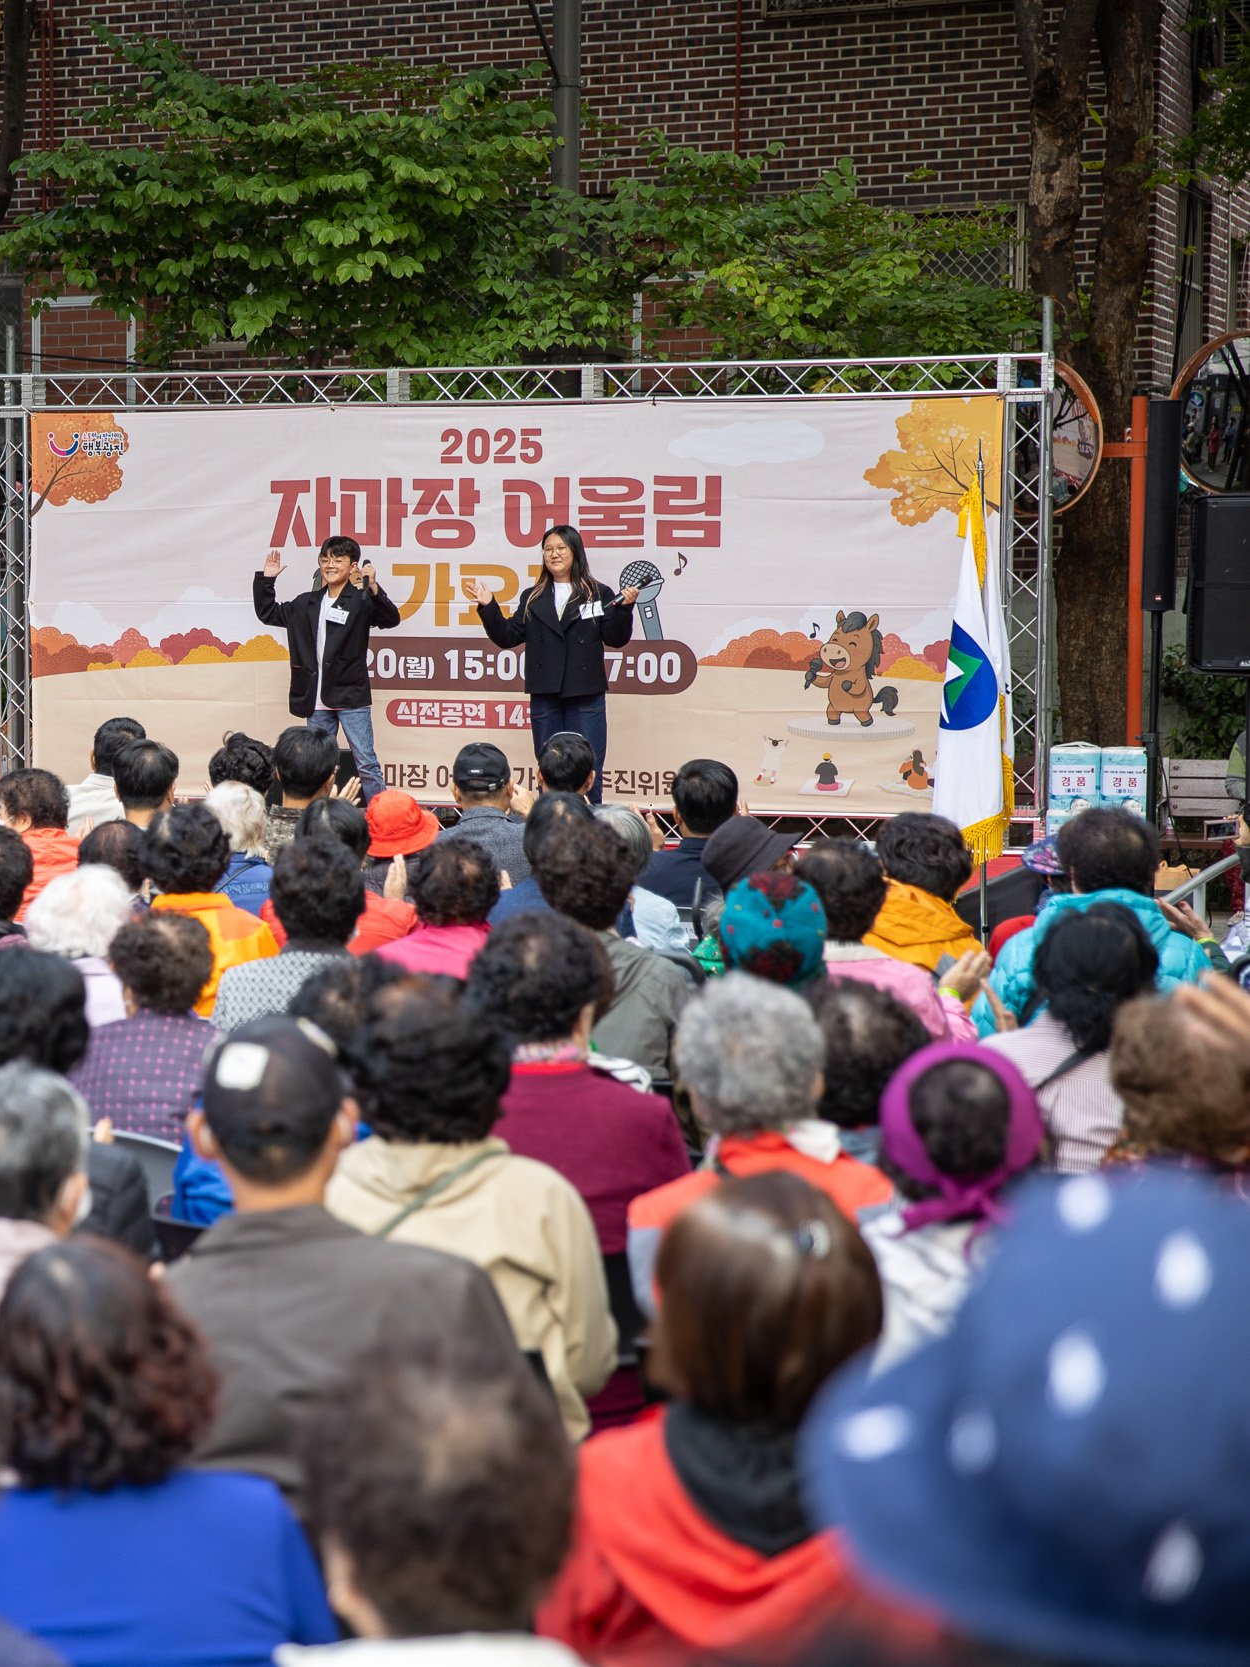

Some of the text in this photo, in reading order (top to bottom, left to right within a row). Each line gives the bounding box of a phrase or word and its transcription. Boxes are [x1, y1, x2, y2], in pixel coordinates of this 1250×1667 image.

[82, 440, 124, 456] 행복광진
[440, 428, 543, 464] 2025
[269, 475, 722, 549] 자마장 어울림
[392, 562, 541, 627] 가요
[444, 649, 525, 681] 15:0
[396, 702, 486, 726] 식전공연
[383, 764, 430, 788] 마장
[1061, 776, 1086, 787] 경품
[1112, 777, 1137, 788] 경품
